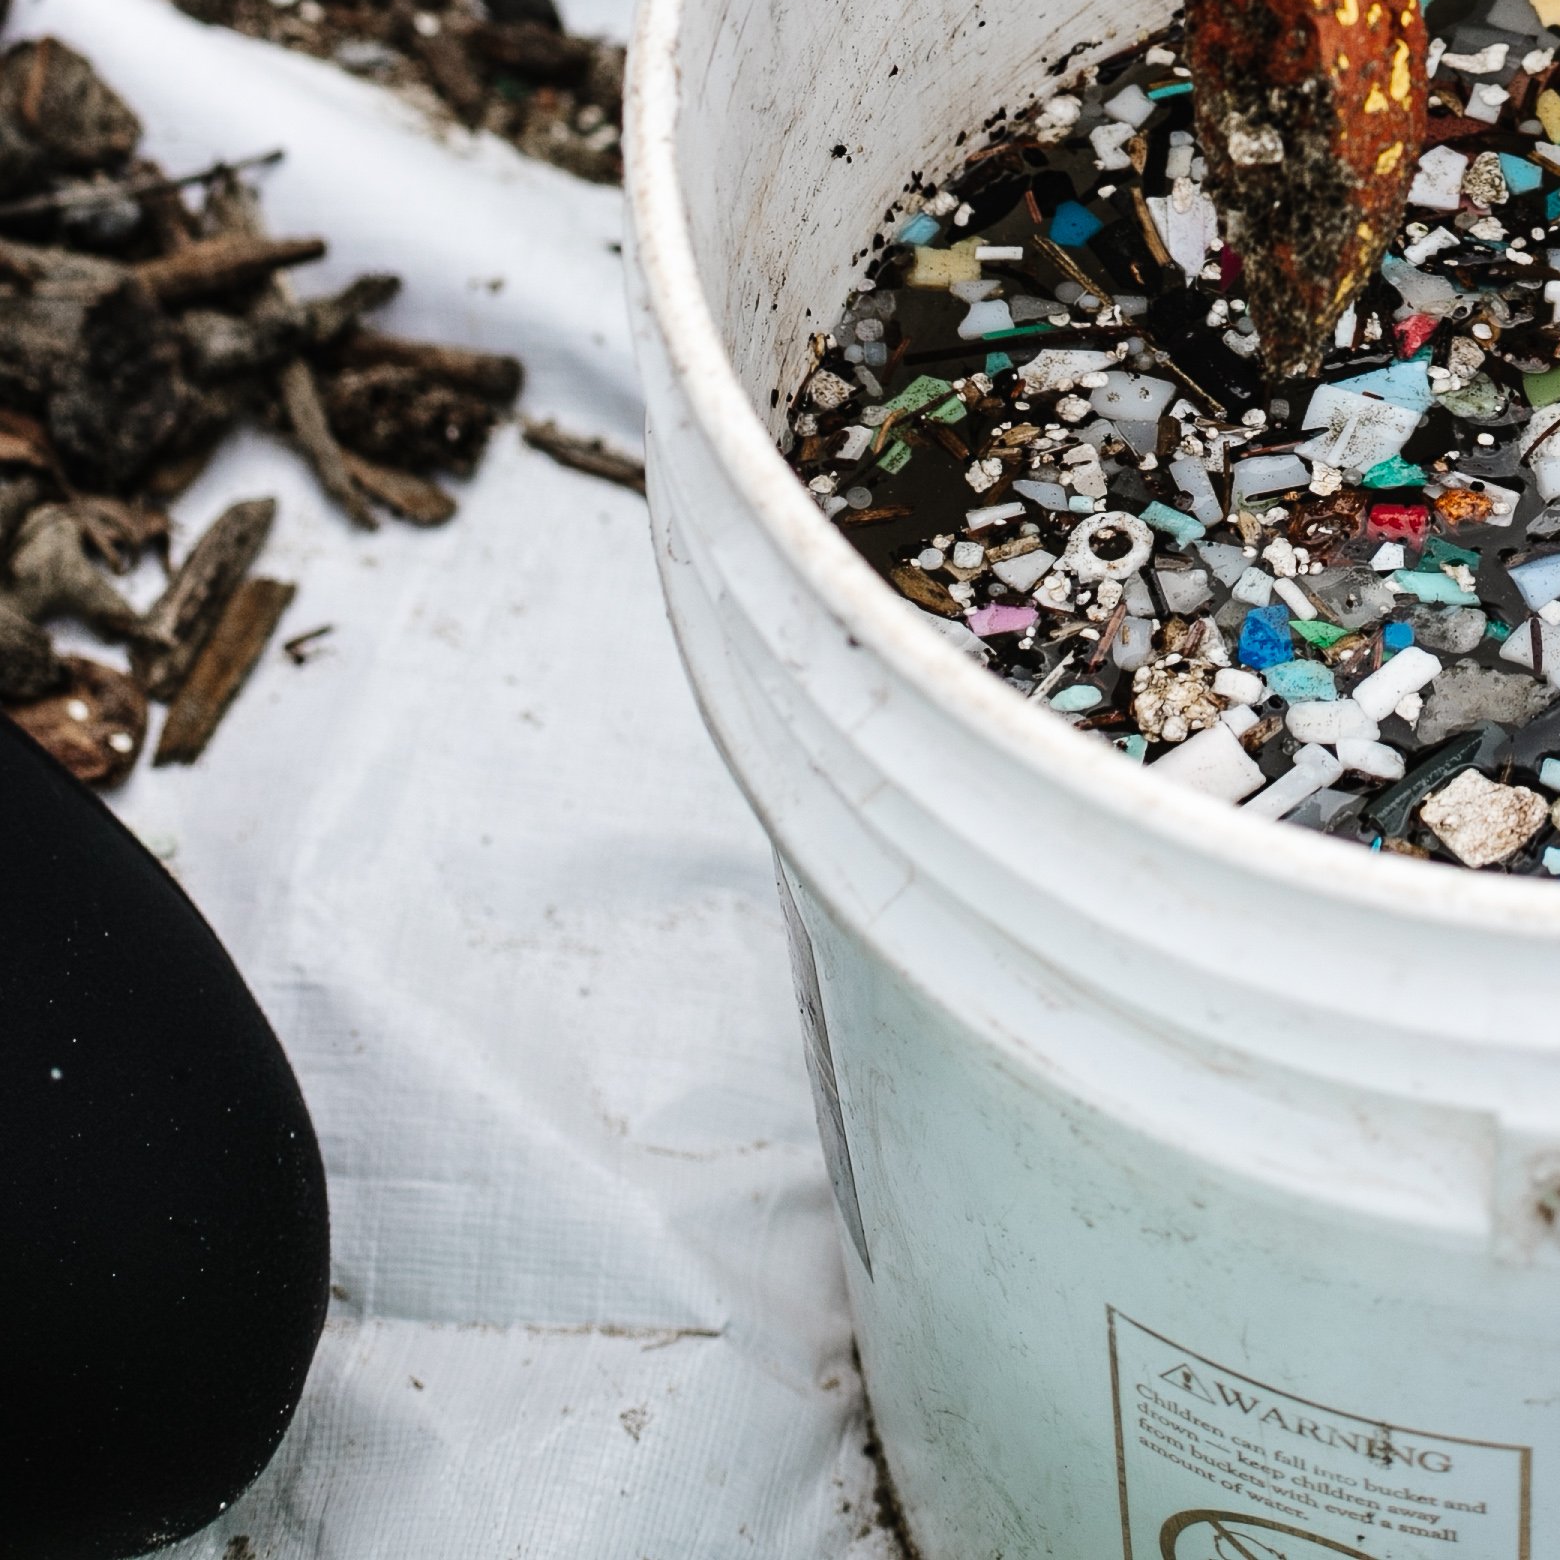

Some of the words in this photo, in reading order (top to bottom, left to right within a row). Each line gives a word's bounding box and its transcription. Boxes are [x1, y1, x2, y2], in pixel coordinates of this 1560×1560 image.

[1135, 1382, 1225, 1439] Children
[1231, 1435, 1266, 1456] can
[1273, 1450, 1306, 1471] fall
[1313, 1463, 1357, 1487] into
[1363, 1478, 1439, 1506] bucket
[1443, 1498, 1487, 1515] and
[1136, 1400, 1199, 1444] drown
[1236, 1451, 1285, 1484] keep
[1291, 1473, 1381, 1510] children
[1387, 1505, 1441, 1525] away
[1138, 1416, 1188, 1451] from
[1191, 1442, 1266, 1488] buckets
[1269, 1482, 1319, 1509] with
[1380, 1516, 1392, 1529] a
[1397, 1521, 1459, 1542] small
[1139, 1434, 1216, 1484] amount
[1220, 1479, 1244, 1497] of
[1246, 1489, 1309, 1521] water.
[1213, 1379, 1453, 1474] WARNING
